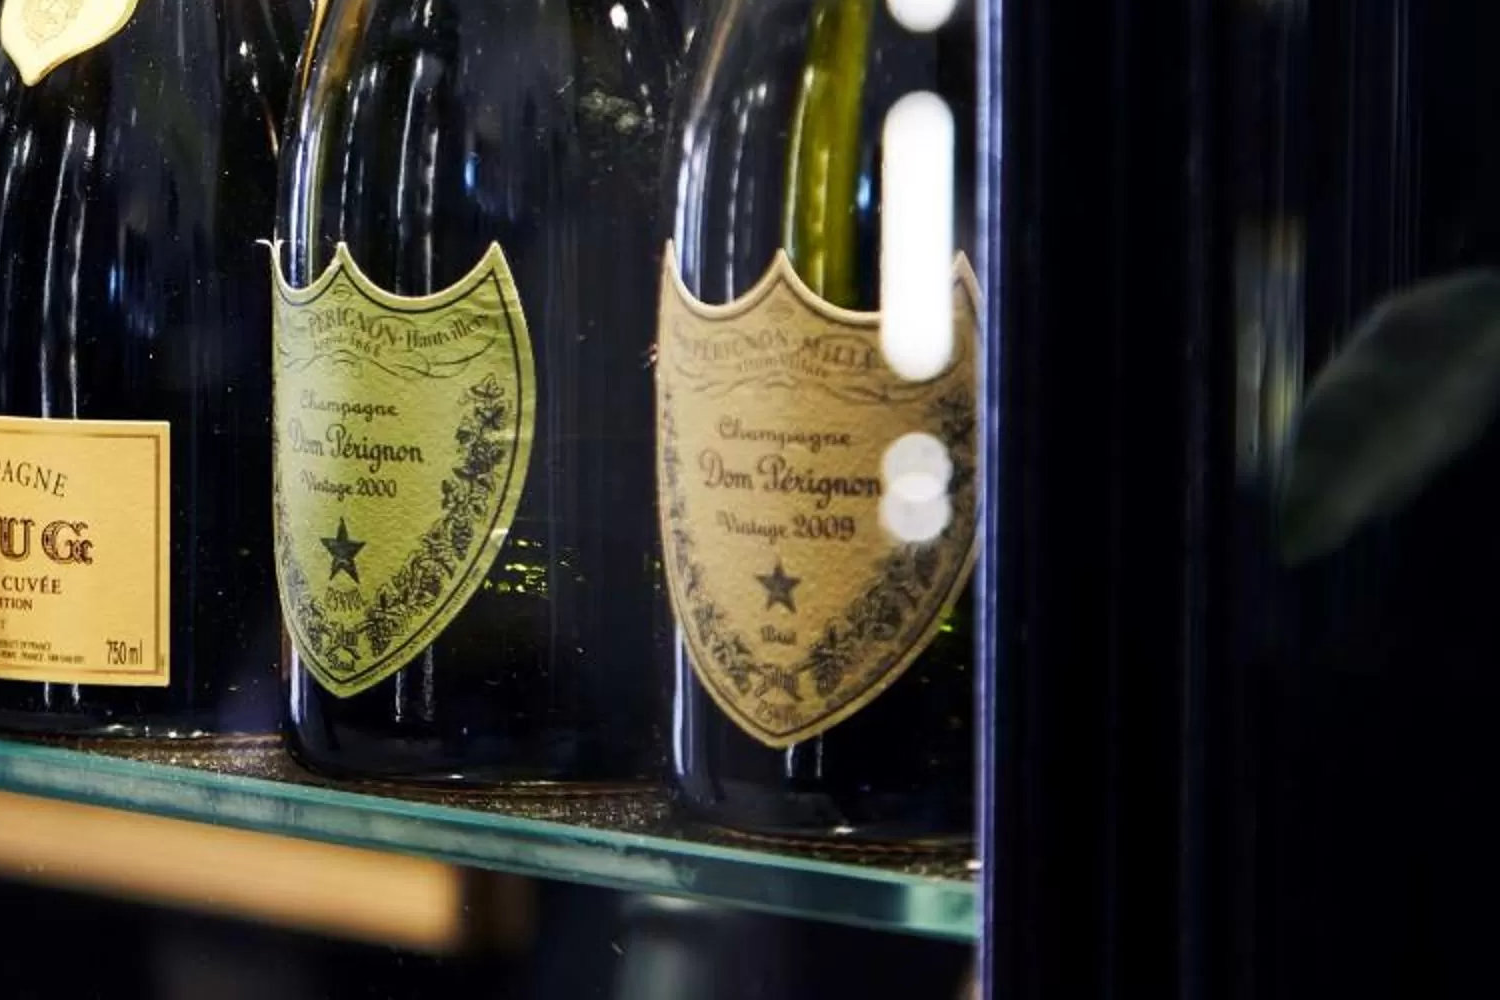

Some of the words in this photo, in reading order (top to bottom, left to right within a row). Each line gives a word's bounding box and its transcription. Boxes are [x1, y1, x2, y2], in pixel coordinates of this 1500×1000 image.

[300, 389, 399, 422] Champagne
[287, 418, 324, 456] Dom
[326, 423, 424, 473] Pérignon
[716, 415, 851, 453] Champagne
[301, 469, 354, 501] Vintage
[356, 477, 397, 498] 2000
[699, 449, 753, 488] Dom
[756, 454, 882, 509] Pérignon
[716, 510, 788, 545] Vintage
[792, 514, 855, 541] 2009
[1, 574, 62, 595] CUVÉE
[106, 638, 127, 665] 750
